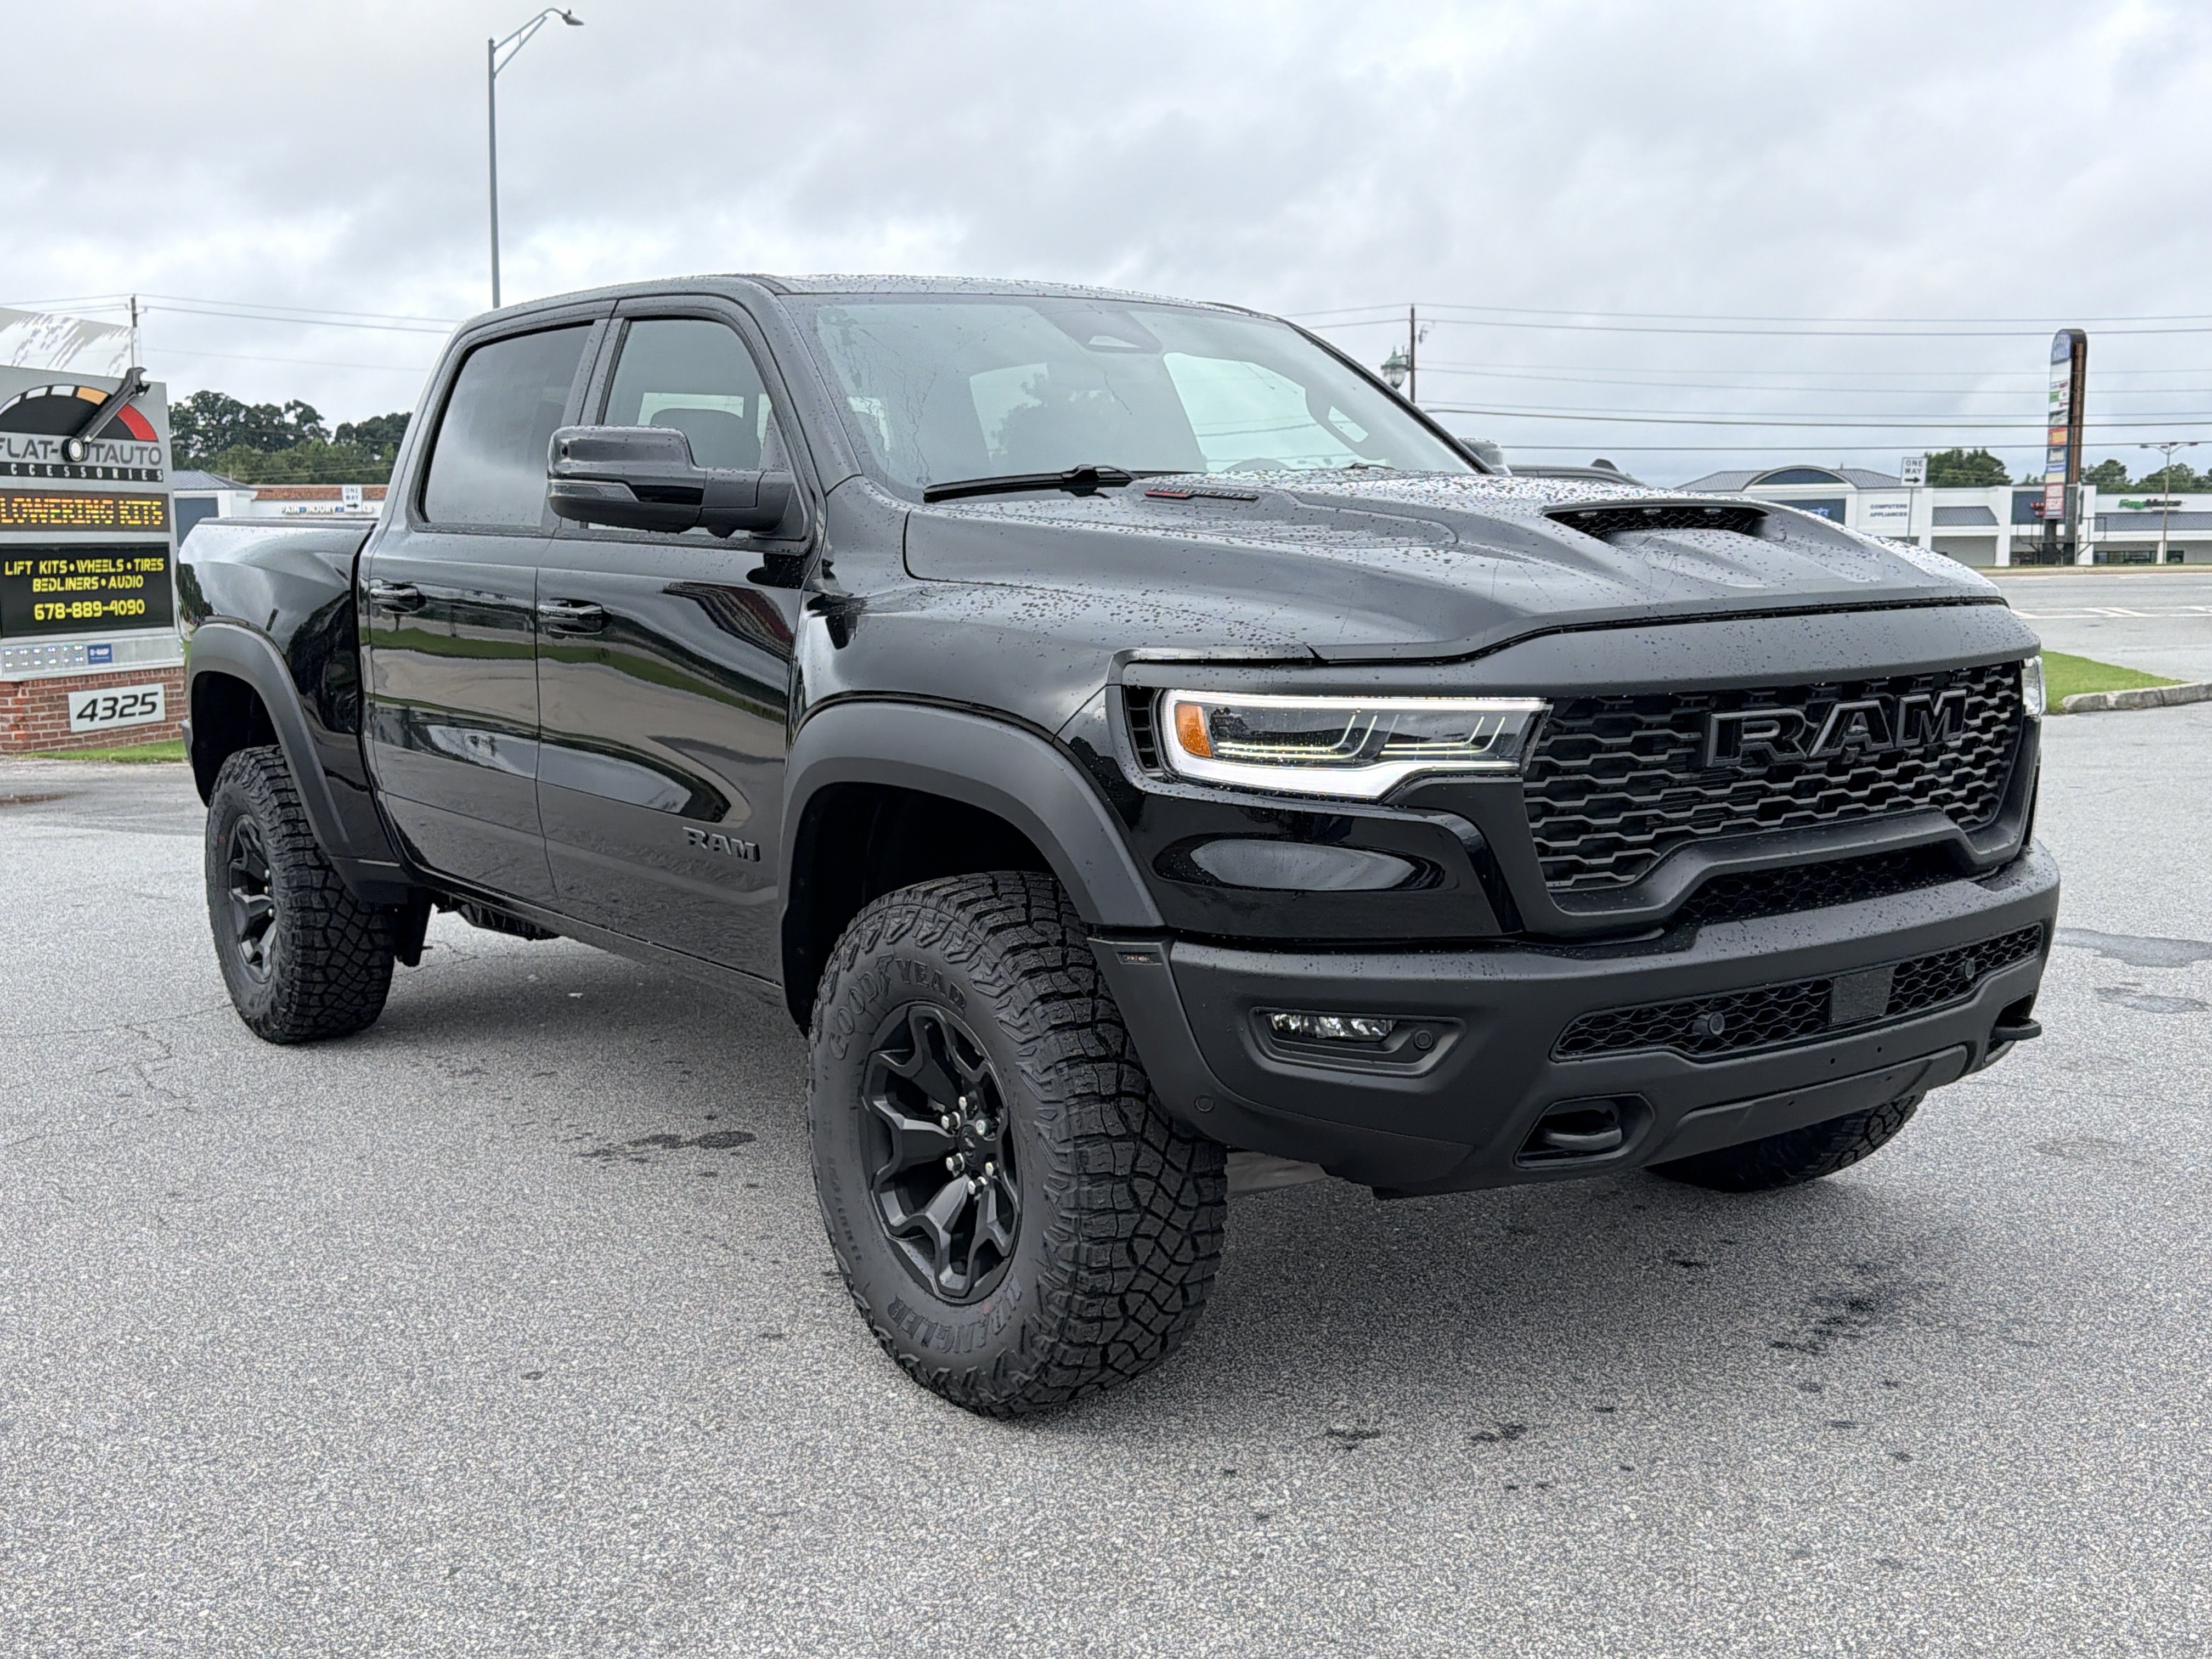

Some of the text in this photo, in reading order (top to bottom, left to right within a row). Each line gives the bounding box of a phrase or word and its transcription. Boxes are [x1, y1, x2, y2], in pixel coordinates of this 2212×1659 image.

[0, 496, 163, 525] LOWERING KITS
[4, 561, 33, 576] LIFT
[33, 599, 146, 621] 678-889-4090
[76, 691, 159, 722] 4325
[1706, 689, 1968, 768] RAM
[682, 826, 761, 862] RAM
